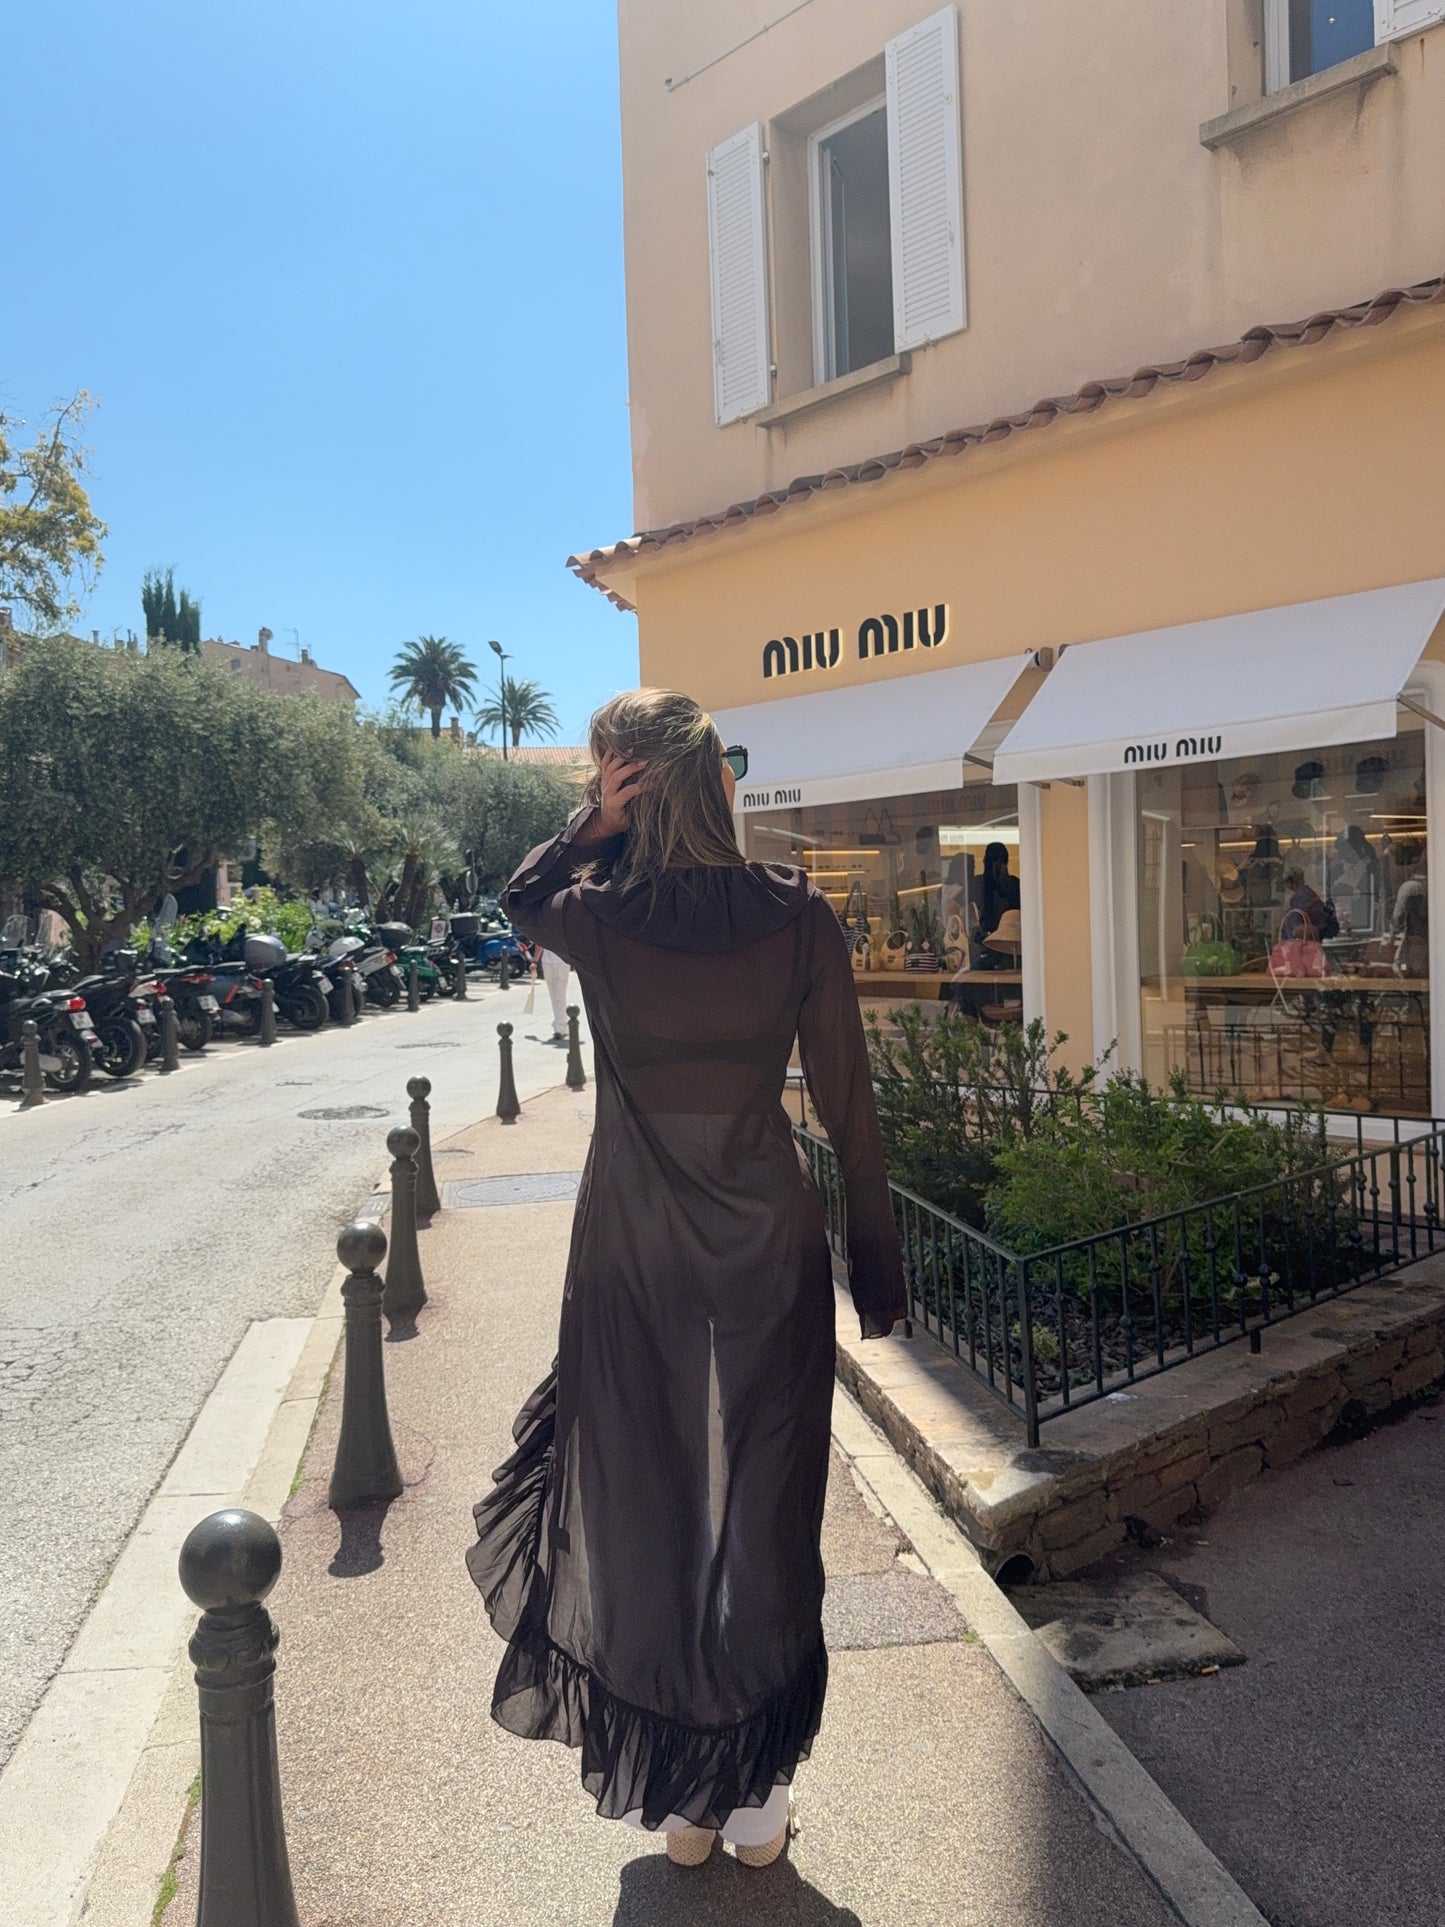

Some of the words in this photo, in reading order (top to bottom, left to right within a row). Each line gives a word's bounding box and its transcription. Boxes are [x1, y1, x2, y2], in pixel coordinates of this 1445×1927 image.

[762, 628, 841, 678] MIU
[859, 604, 946, 659] MIU
[1124, 742, 1167, 763] MIU
[1176, 736, 1222, 757] MIU
[743, 792, 769, 807] MIU
[775, 788, 801, 804] MIU
